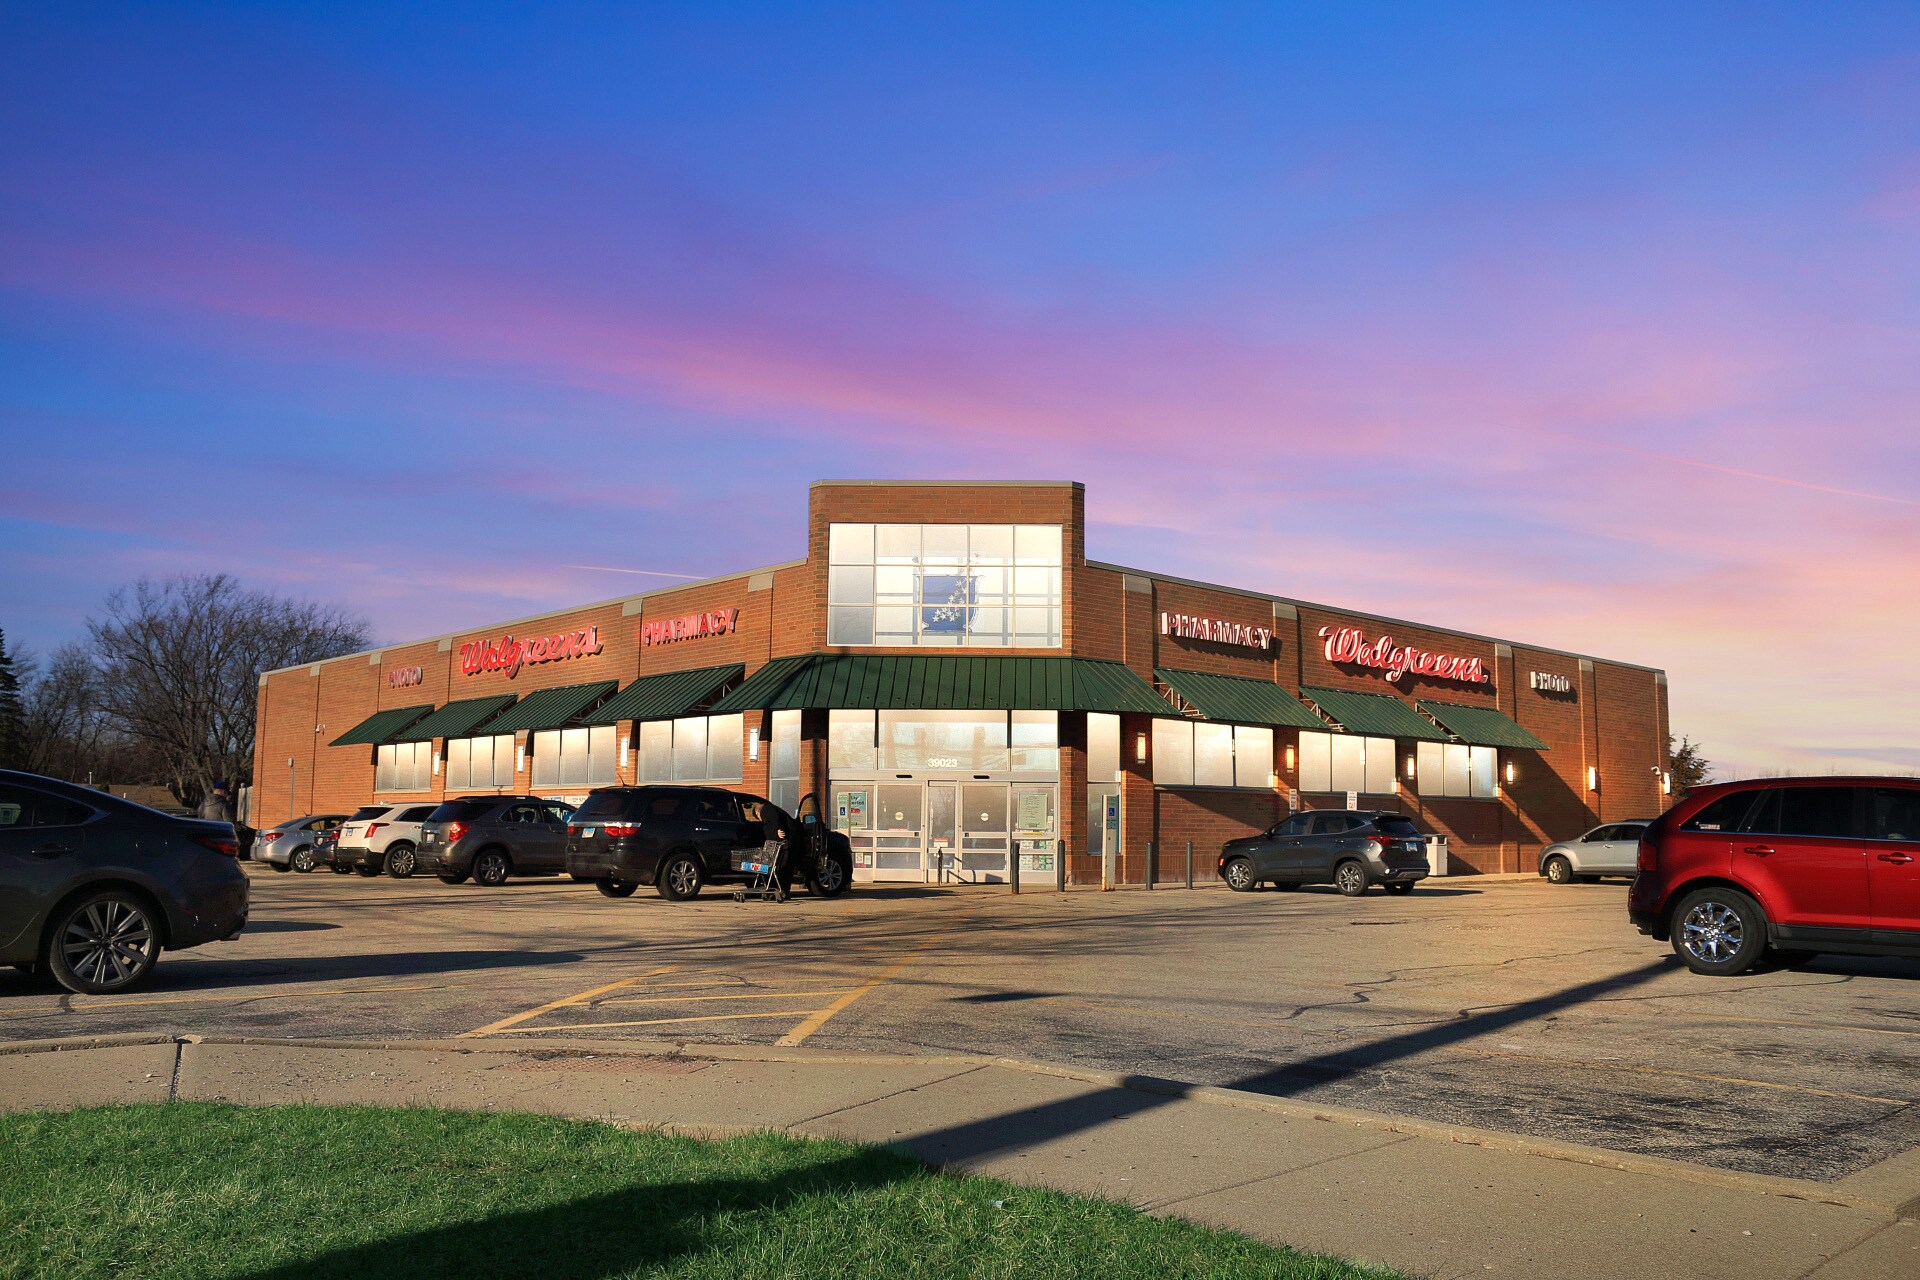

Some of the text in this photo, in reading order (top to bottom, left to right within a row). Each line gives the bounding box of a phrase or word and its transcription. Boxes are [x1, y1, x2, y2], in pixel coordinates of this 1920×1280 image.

[642, 608, 738, 645] PHARMACY
[1161, 612, 1272, 649] PHARMACY
[460, 626, 603, 678] Walgreens
[1318, 626, 1488, 682] Walgreens
[1530, 671, 1570, 692] PHOTO
[927, 758, 958, 768] 39023
